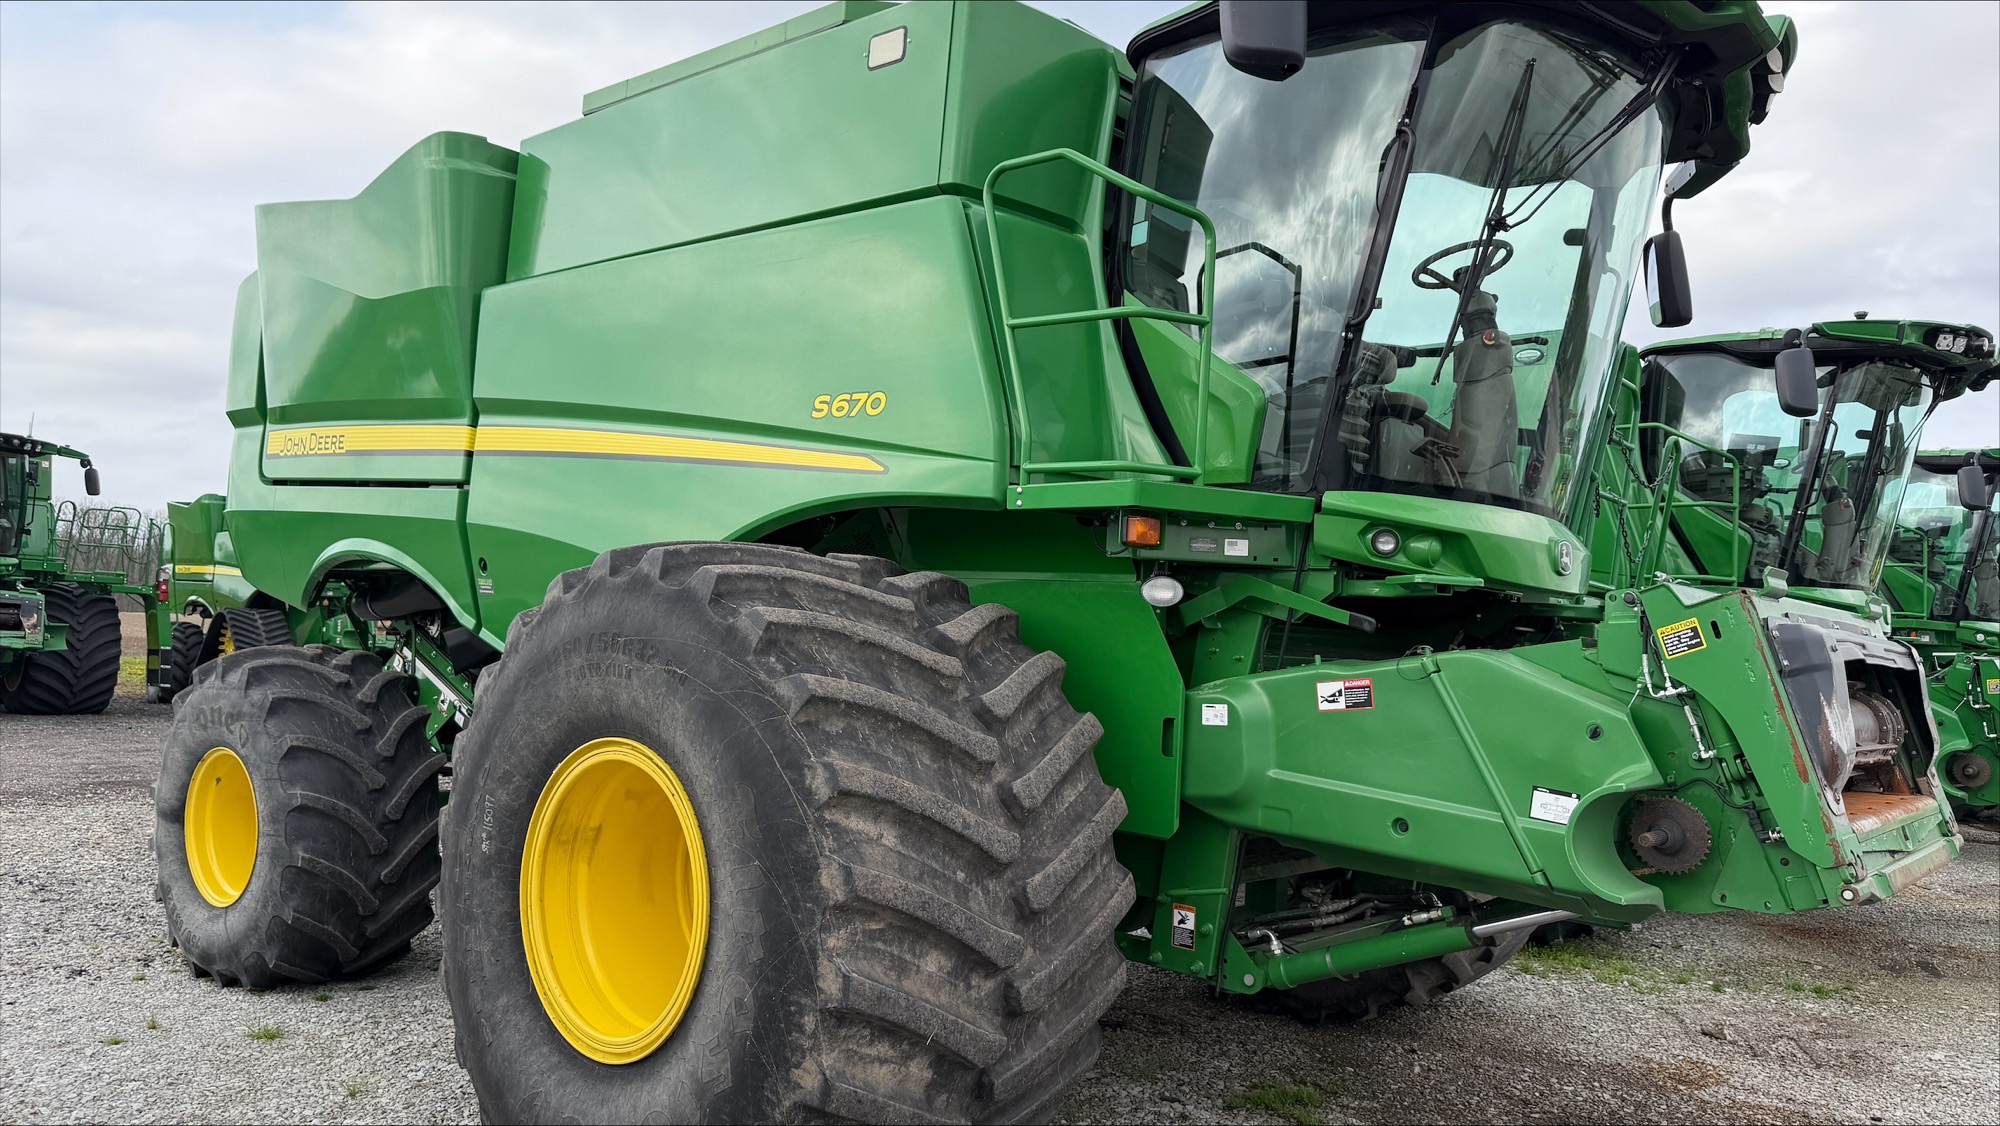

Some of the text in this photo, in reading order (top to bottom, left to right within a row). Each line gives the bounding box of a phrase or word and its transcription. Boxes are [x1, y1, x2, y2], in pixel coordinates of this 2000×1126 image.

[811, 391, 887, 419] S670
[280, 432, 345, 453] JOHN DEERE
[1664, 619, 1697, 634] CAUTION
[482, 794, 496, 831] 115097
